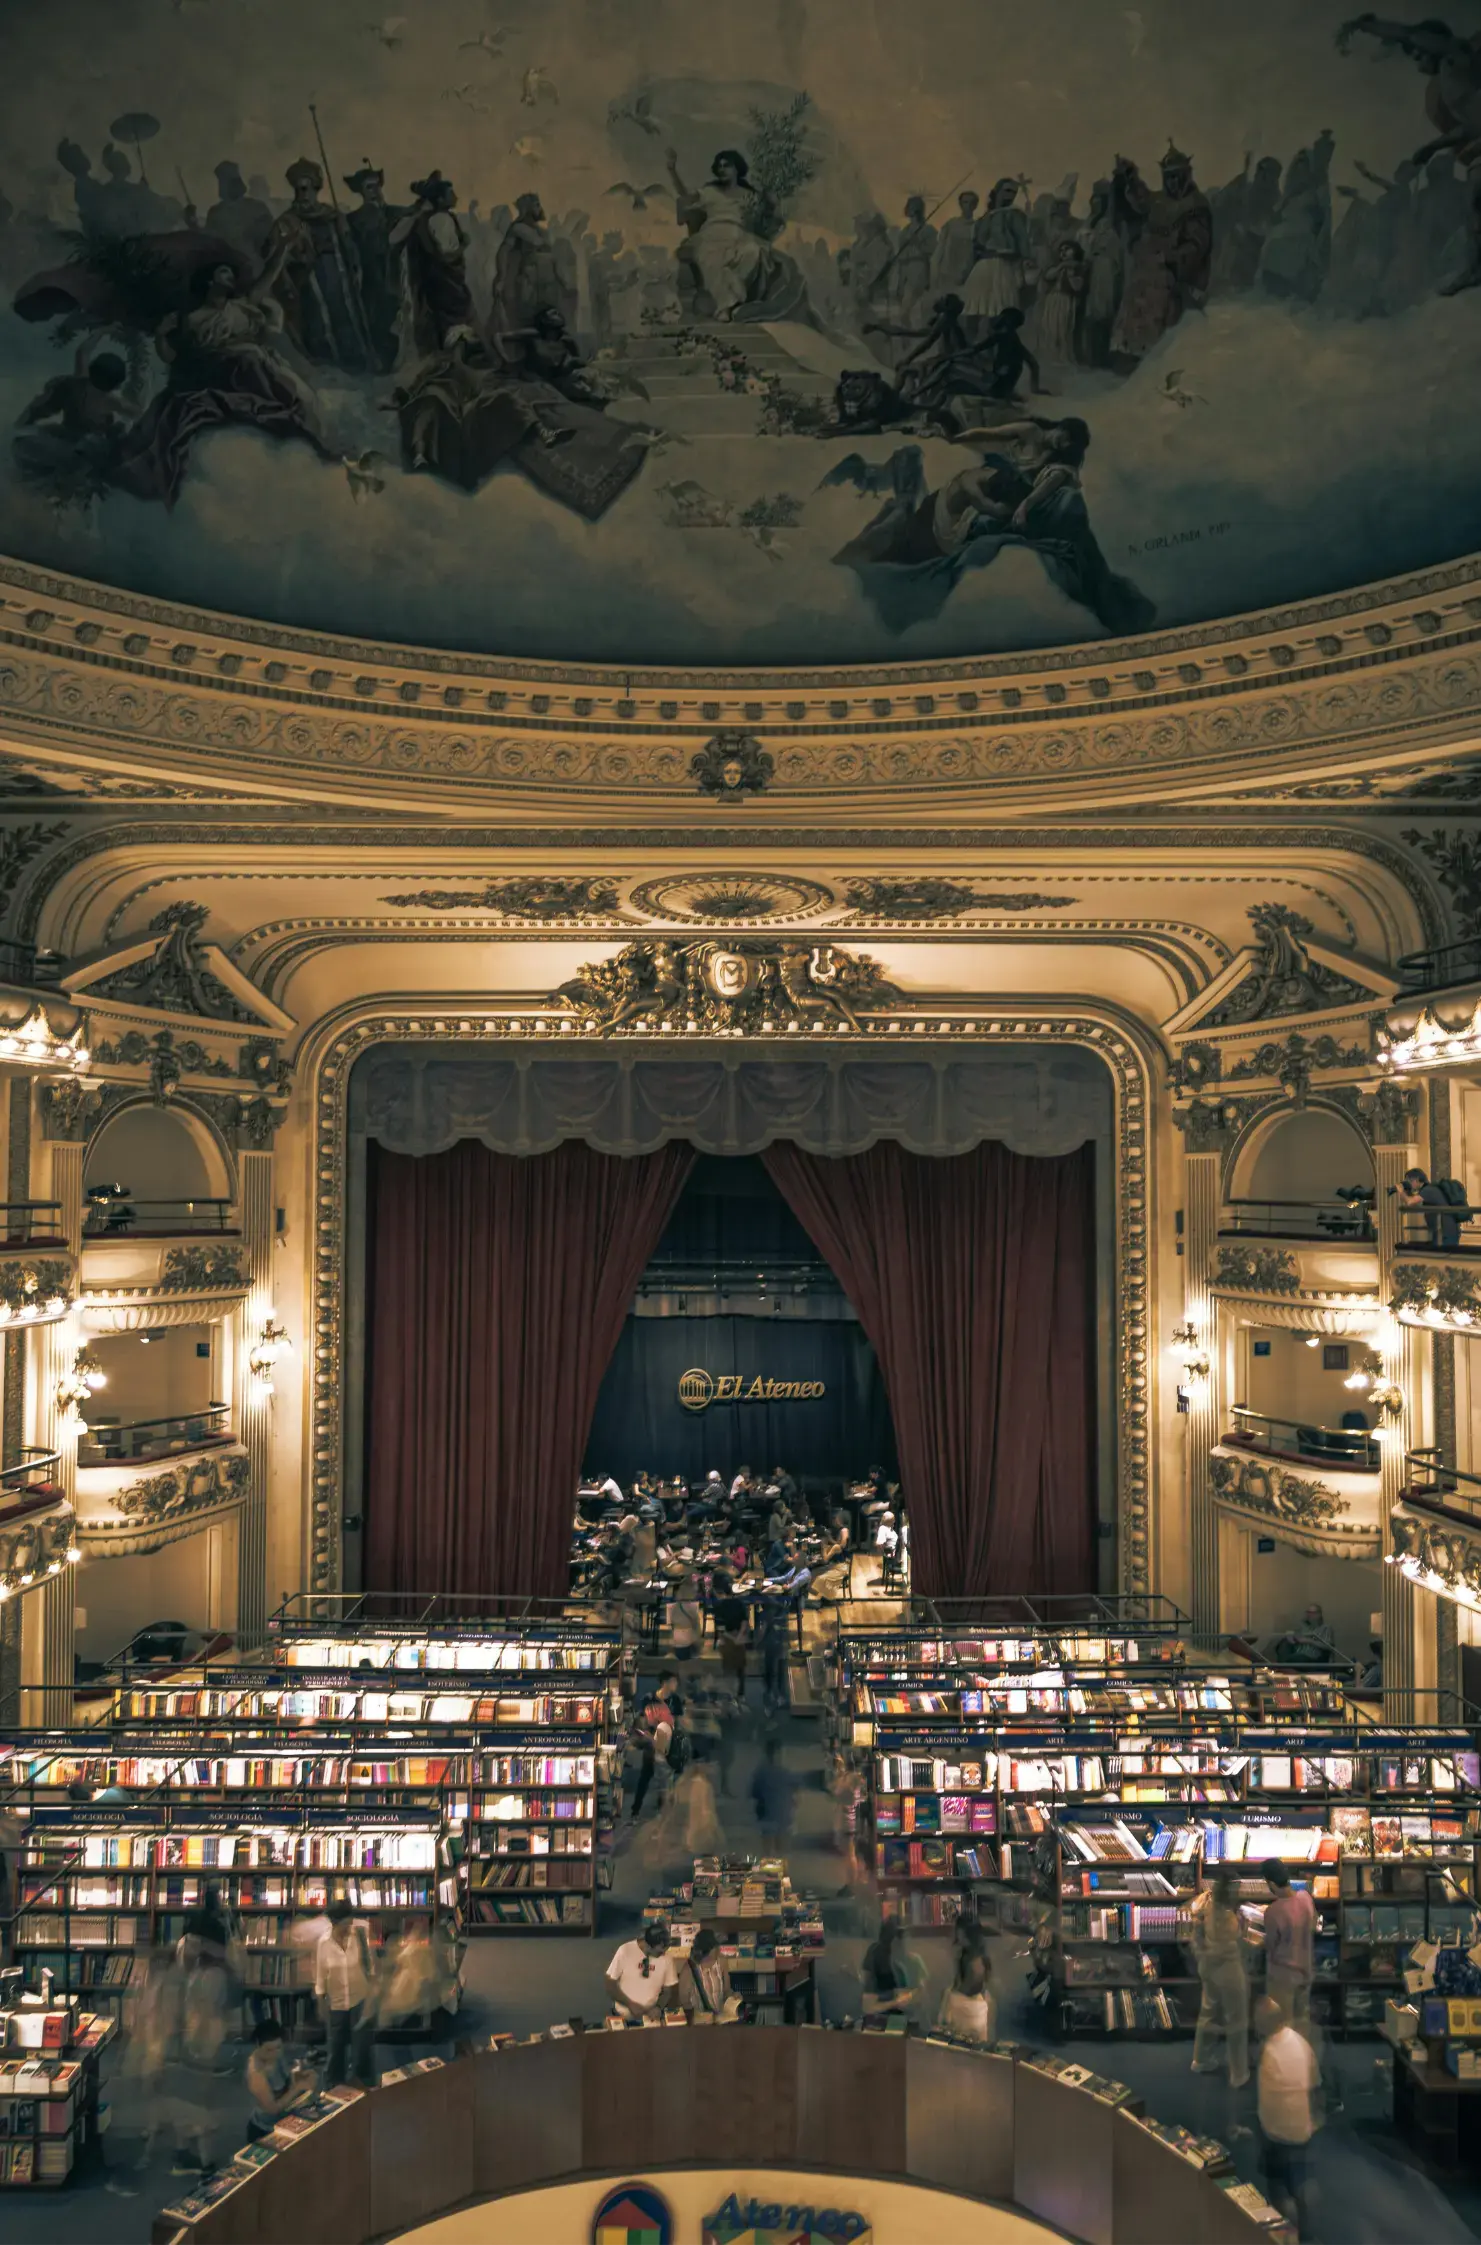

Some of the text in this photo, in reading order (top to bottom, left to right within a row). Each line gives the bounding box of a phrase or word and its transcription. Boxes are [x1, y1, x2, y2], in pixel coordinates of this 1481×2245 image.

[713, 1374, 825, 1400] El Ateneo
[923, 1736, 969, 1744] ARGENTINO
[1046, 1737, 1065, 1745] ARTE
[1285, 1738, 1306, 1746] ARTE
[1406, 1739, 1427, 1747] ARTE
[1103, 1811, 1142, 1820] TURISMO
[1242, 1815, 1282, 1823] TURISMO
[711, 2191, 873, 2239] Ateneo
